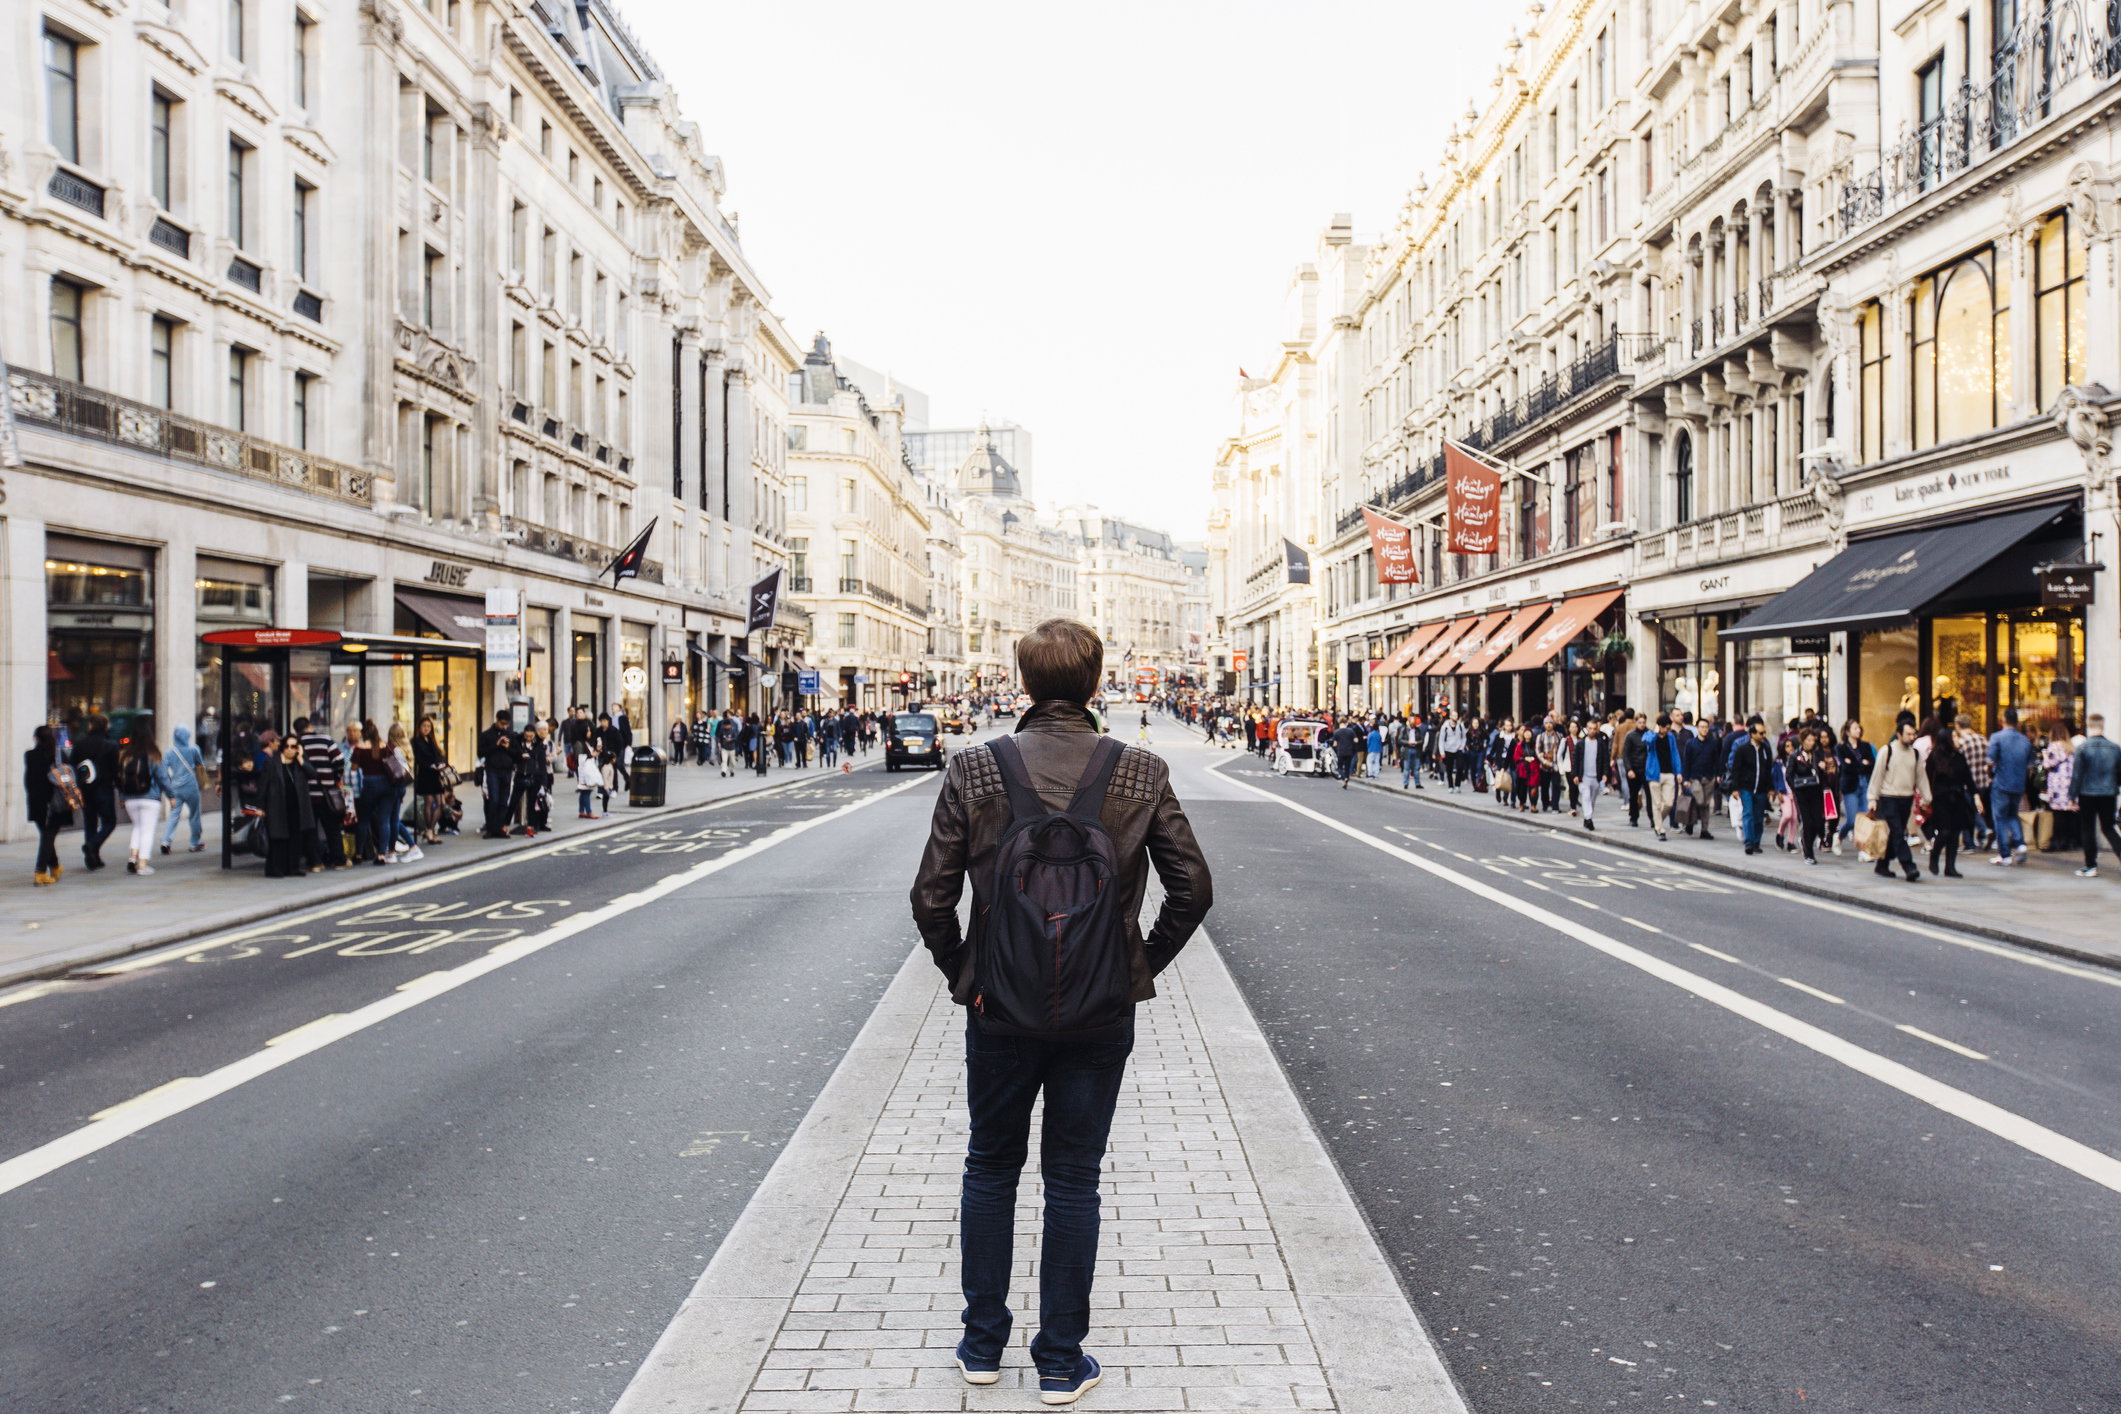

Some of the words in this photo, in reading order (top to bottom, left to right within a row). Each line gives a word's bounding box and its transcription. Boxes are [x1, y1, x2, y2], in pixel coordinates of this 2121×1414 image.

[1454, 475, 1495, 499] Hamleys
[1917, 476, 1944, 502] spade
[1961, 472, 1981, 488] NEW
[1985, 465, 2011, 483] YORK
[1454, 502, 1493, 525] Hamleys
[1376, 525, 1406, 541] Hamleys
[1454, 528, 1493, 551] Hamleys
[1380, 544, 1410, 559] Hamleys
[424, 561, 473, 588] BOSE
[1384, 562, 1414, 579] Hamleys
[1700, 575, 1730, 592] GANT
[613, 828, 750, 842] BUS
[337, 900, 571, 926] BUS
[186, 928, 525, 963] STOP
